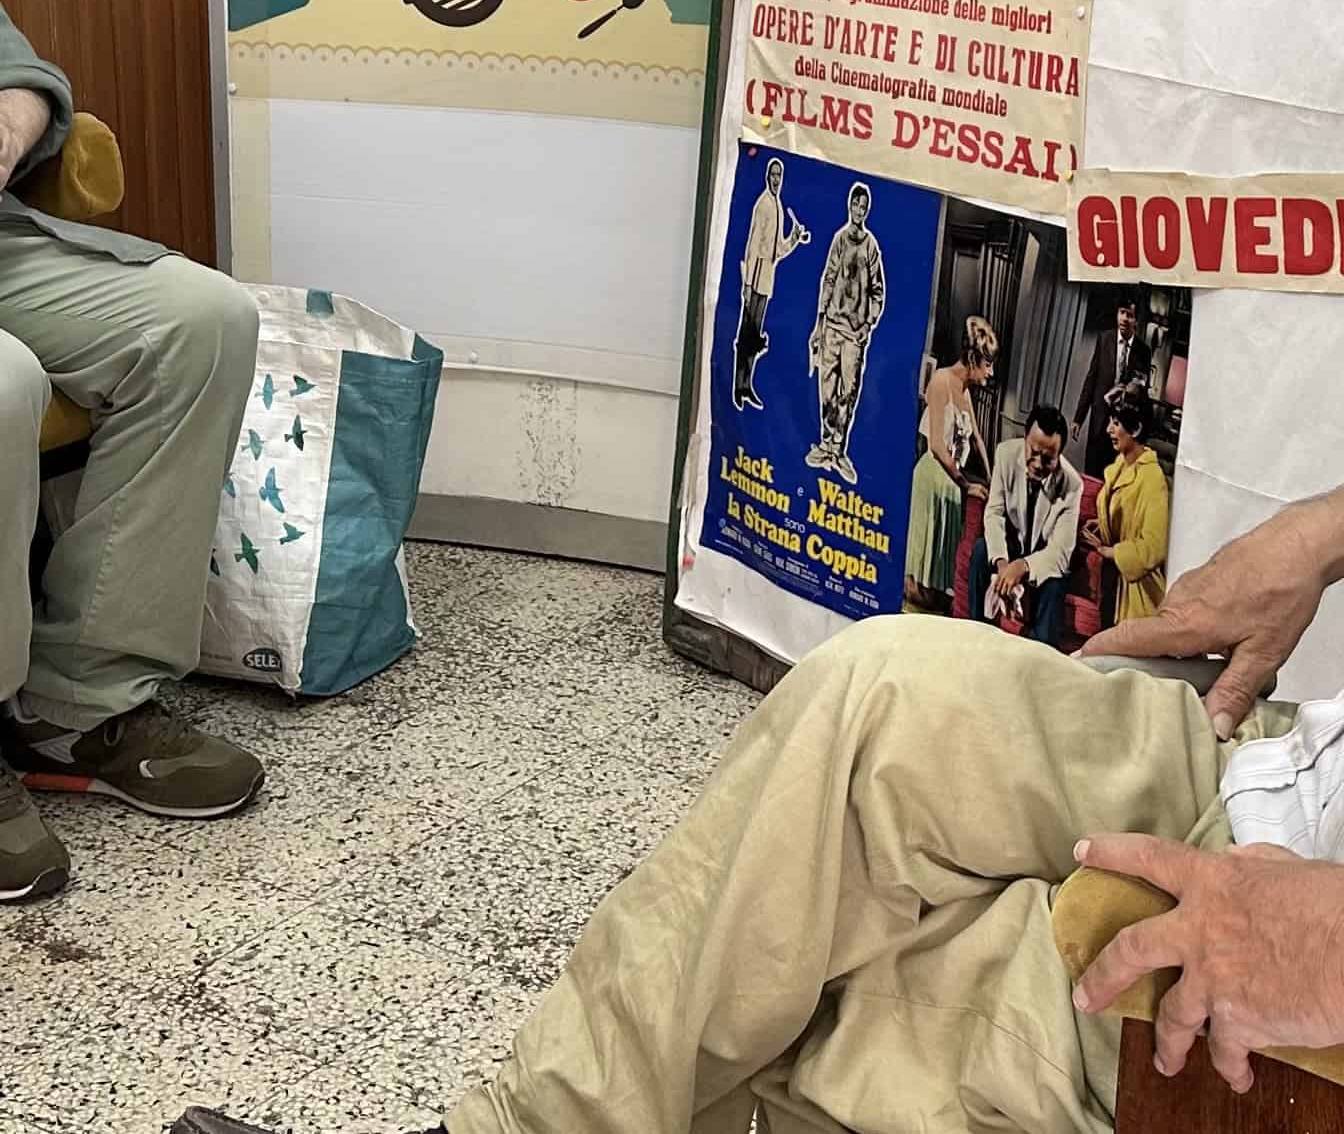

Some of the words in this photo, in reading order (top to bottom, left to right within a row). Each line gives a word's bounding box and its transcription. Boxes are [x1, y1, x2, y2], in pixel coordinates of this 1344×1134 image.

[752, 3, 814, 47] OPERE
[824, 13, 899, 64] D'ARTE
[908, 30, 924, 66] E
[934, 33, 959, 73] DI
[967, 39, 1080, 98] CULTURA
[991, 2, 1052, 34] migliori
[794, 55, 826, 81] della
[831, 59, 937, 104] Cinematografia
[942, 86, 1008, 118] mondiale
[746, 78, 873, 140] (FILMS
[891, 108, 1078, 183] D'ESSAI)
[720, 456, 790, 514] Lemmon
[817, 477, 885, 526] Walter
[735, 445, 774, 484] Jack
[727, 491, 741, 521] la
[743, 504, 801, 555] Strana
[806, 533, 879, 586] Coppia
[807, 499, 890, 554] Matthau
